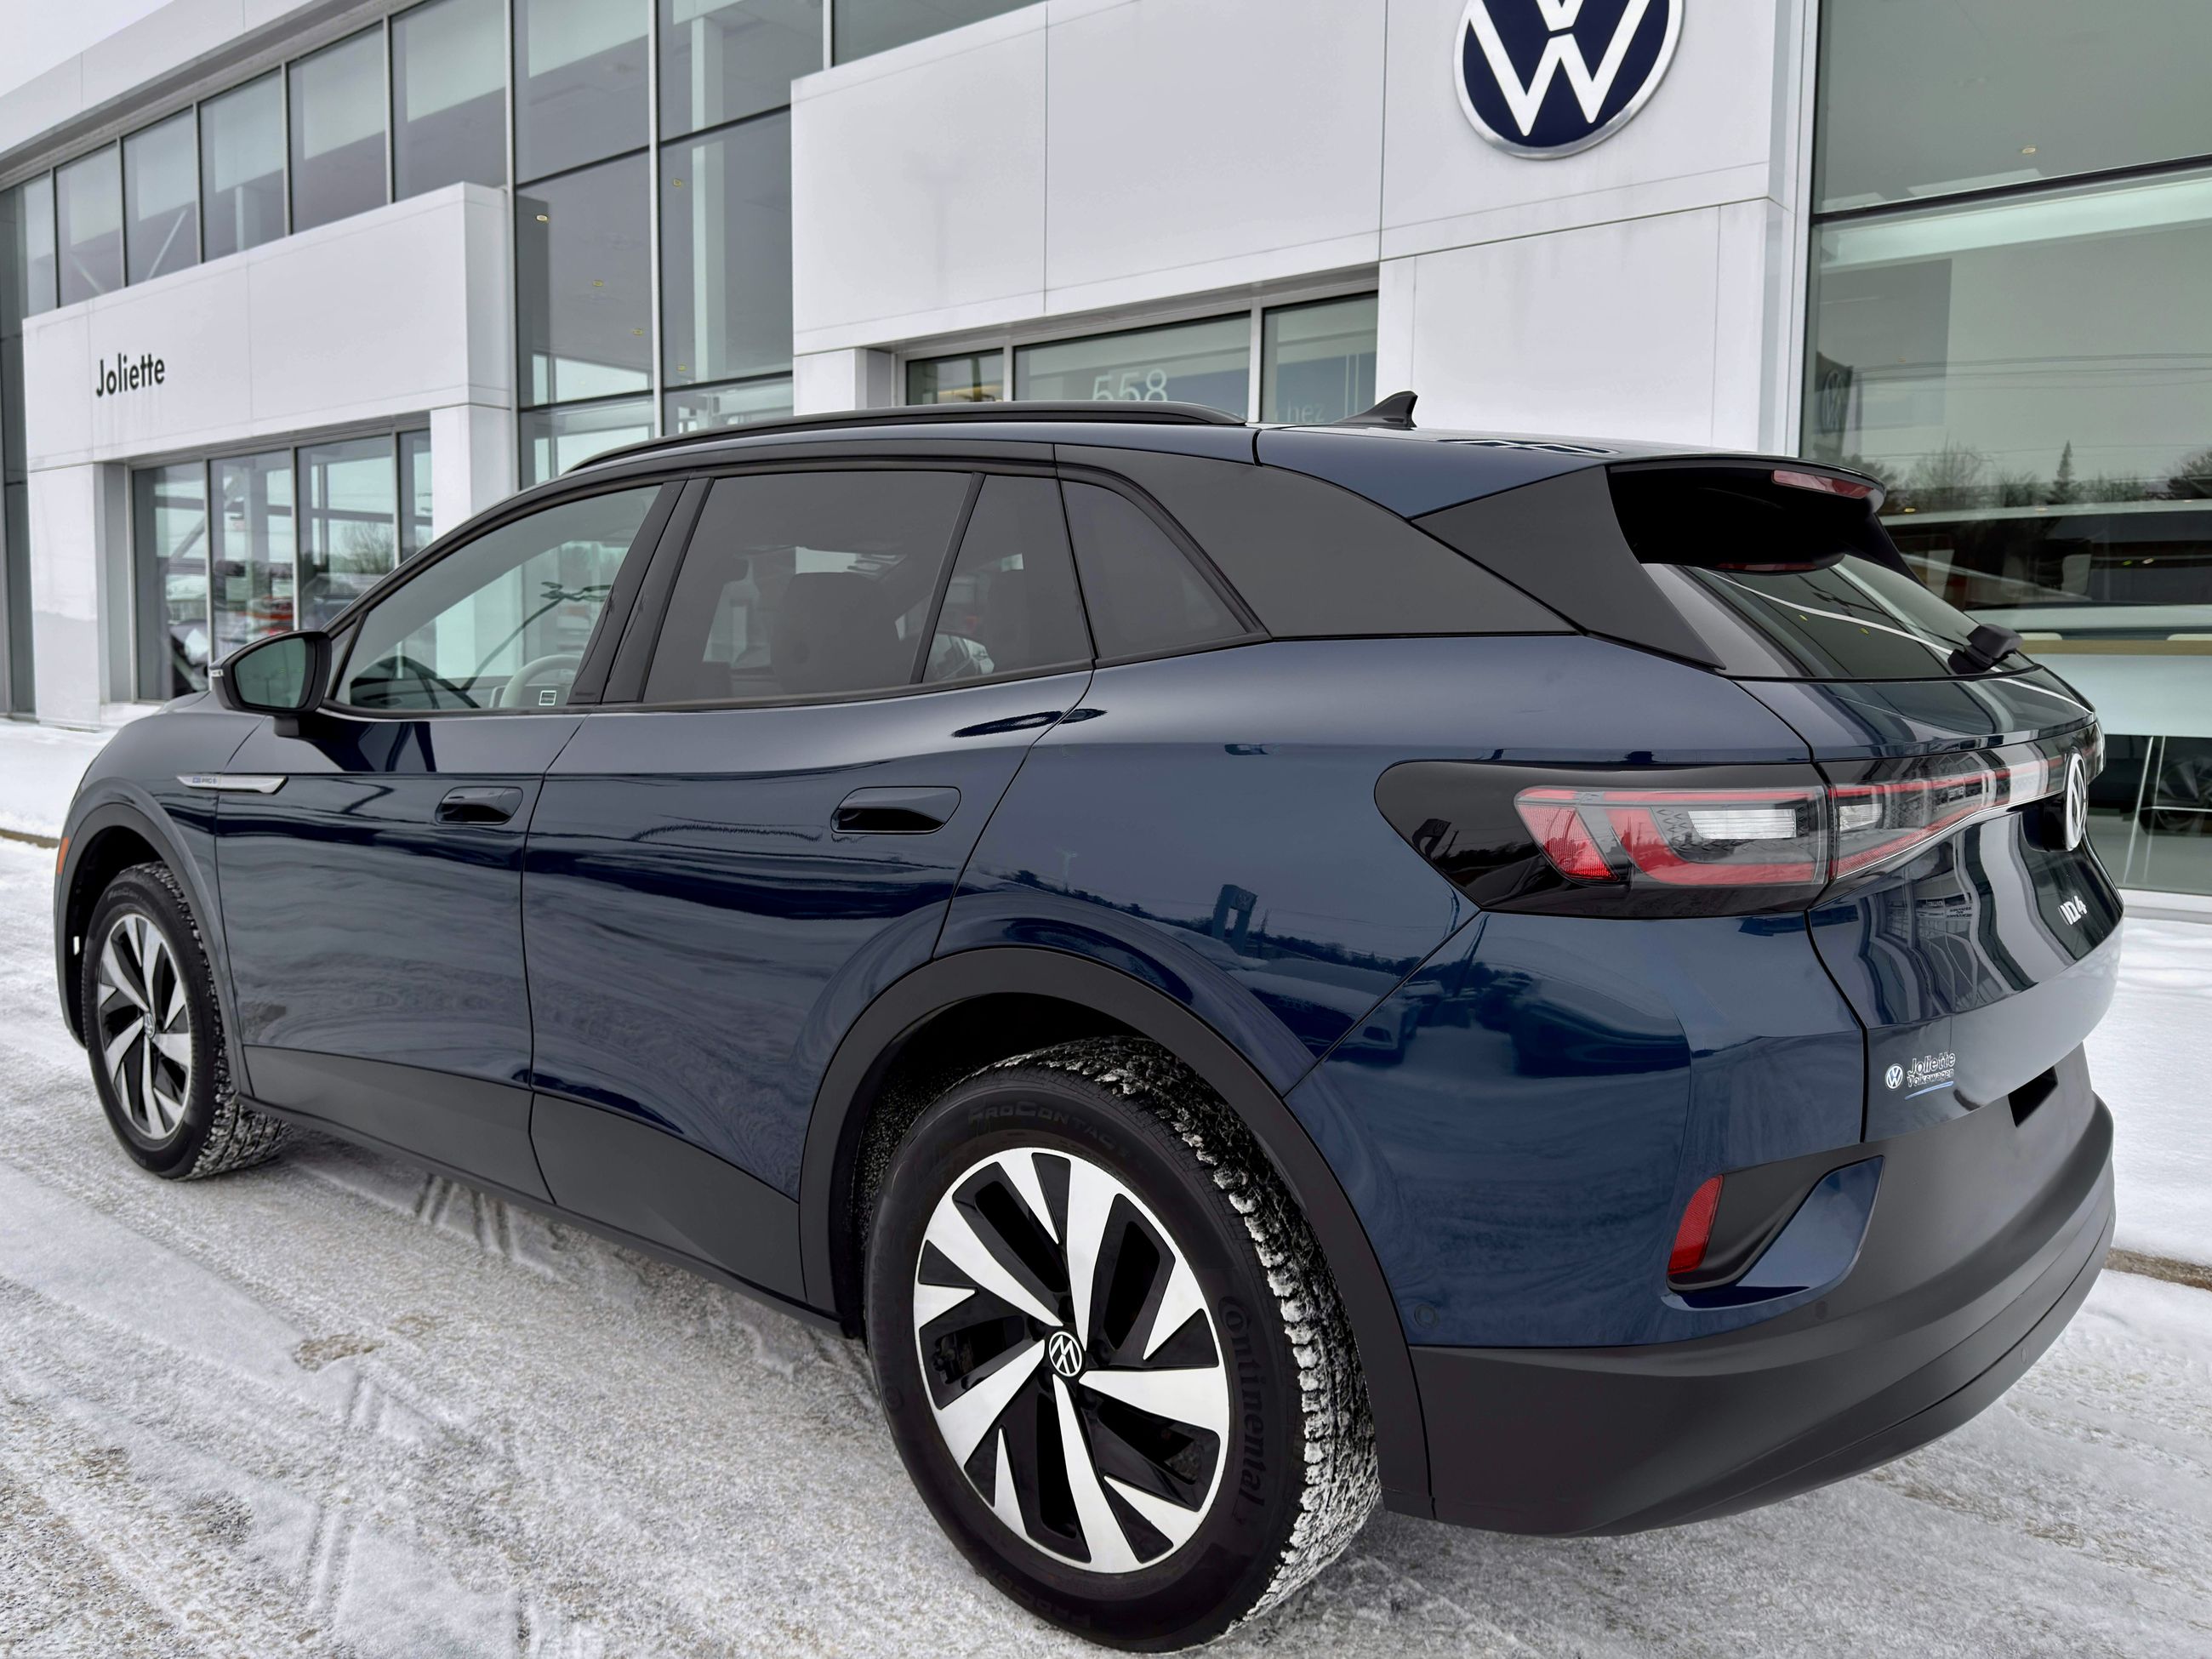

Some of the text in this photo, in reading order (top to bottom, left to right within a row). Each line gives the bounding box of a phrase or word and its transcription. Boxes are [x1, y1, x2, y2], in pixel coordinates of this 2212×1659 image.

[96, 352, 165, 397] Joliette
[1092, 368, 1168, 401] 558
[1907, 1052, 1956, 1076] Joliette
[1217, 1296, 1268, 1508] Continental
